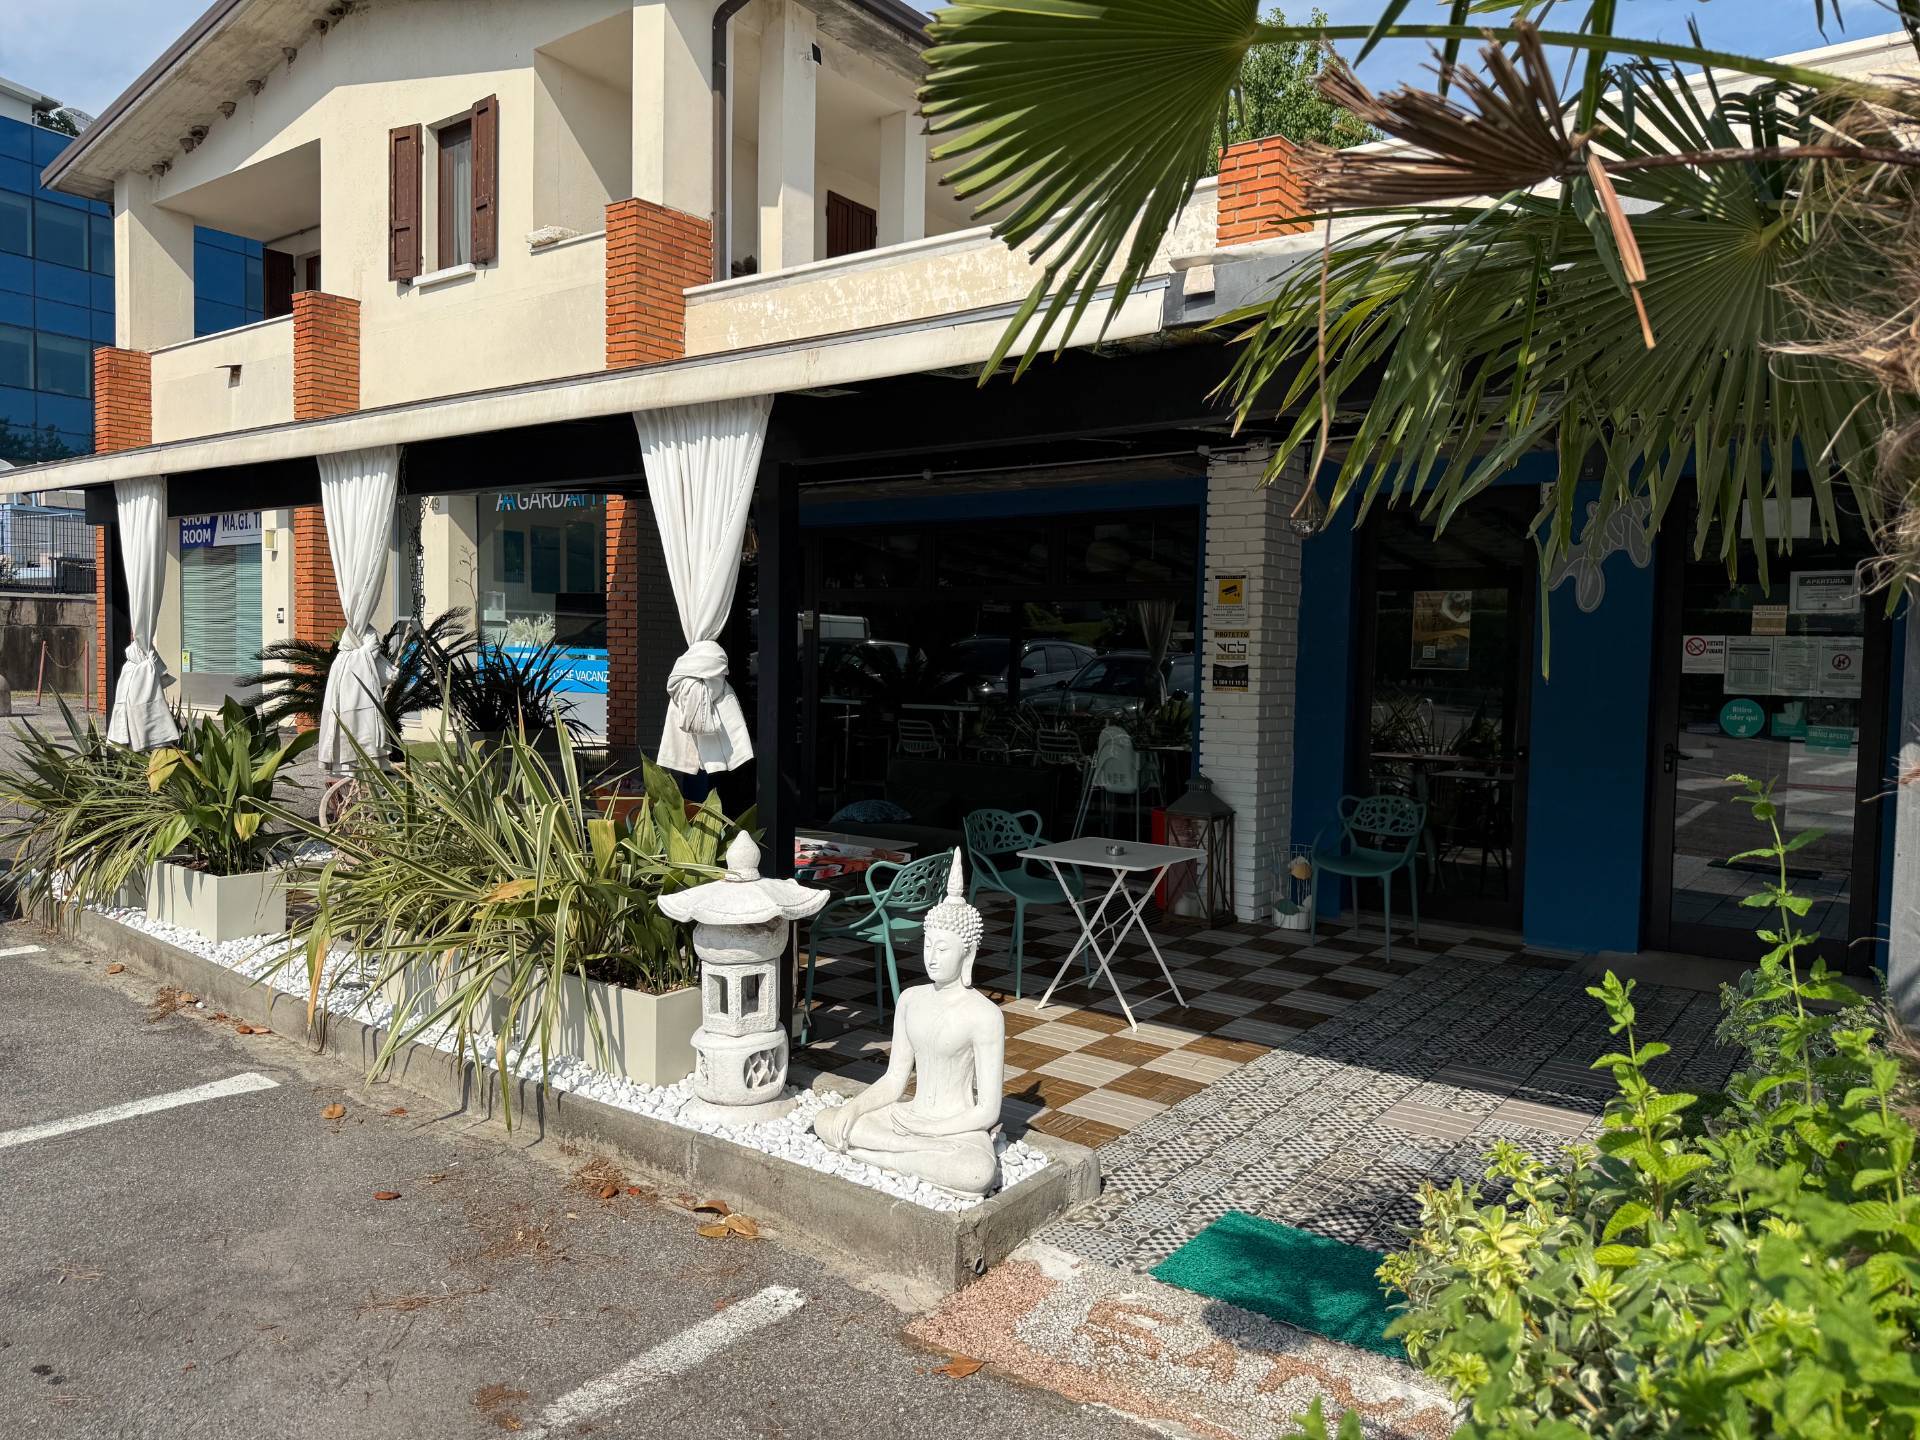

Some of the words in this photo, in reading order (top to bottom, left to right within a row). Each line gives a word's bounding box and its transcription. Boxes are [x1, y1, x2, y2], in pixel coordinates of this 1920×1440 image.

[182, 528, 211, 544] ROOM
[1215, 631, 1249, 639] PROTETTO
[1732, 705, 1753, 714] Ritiro
[1726, 713, 1744, 721] rider
[1745, 714, 1758, 722] qui
